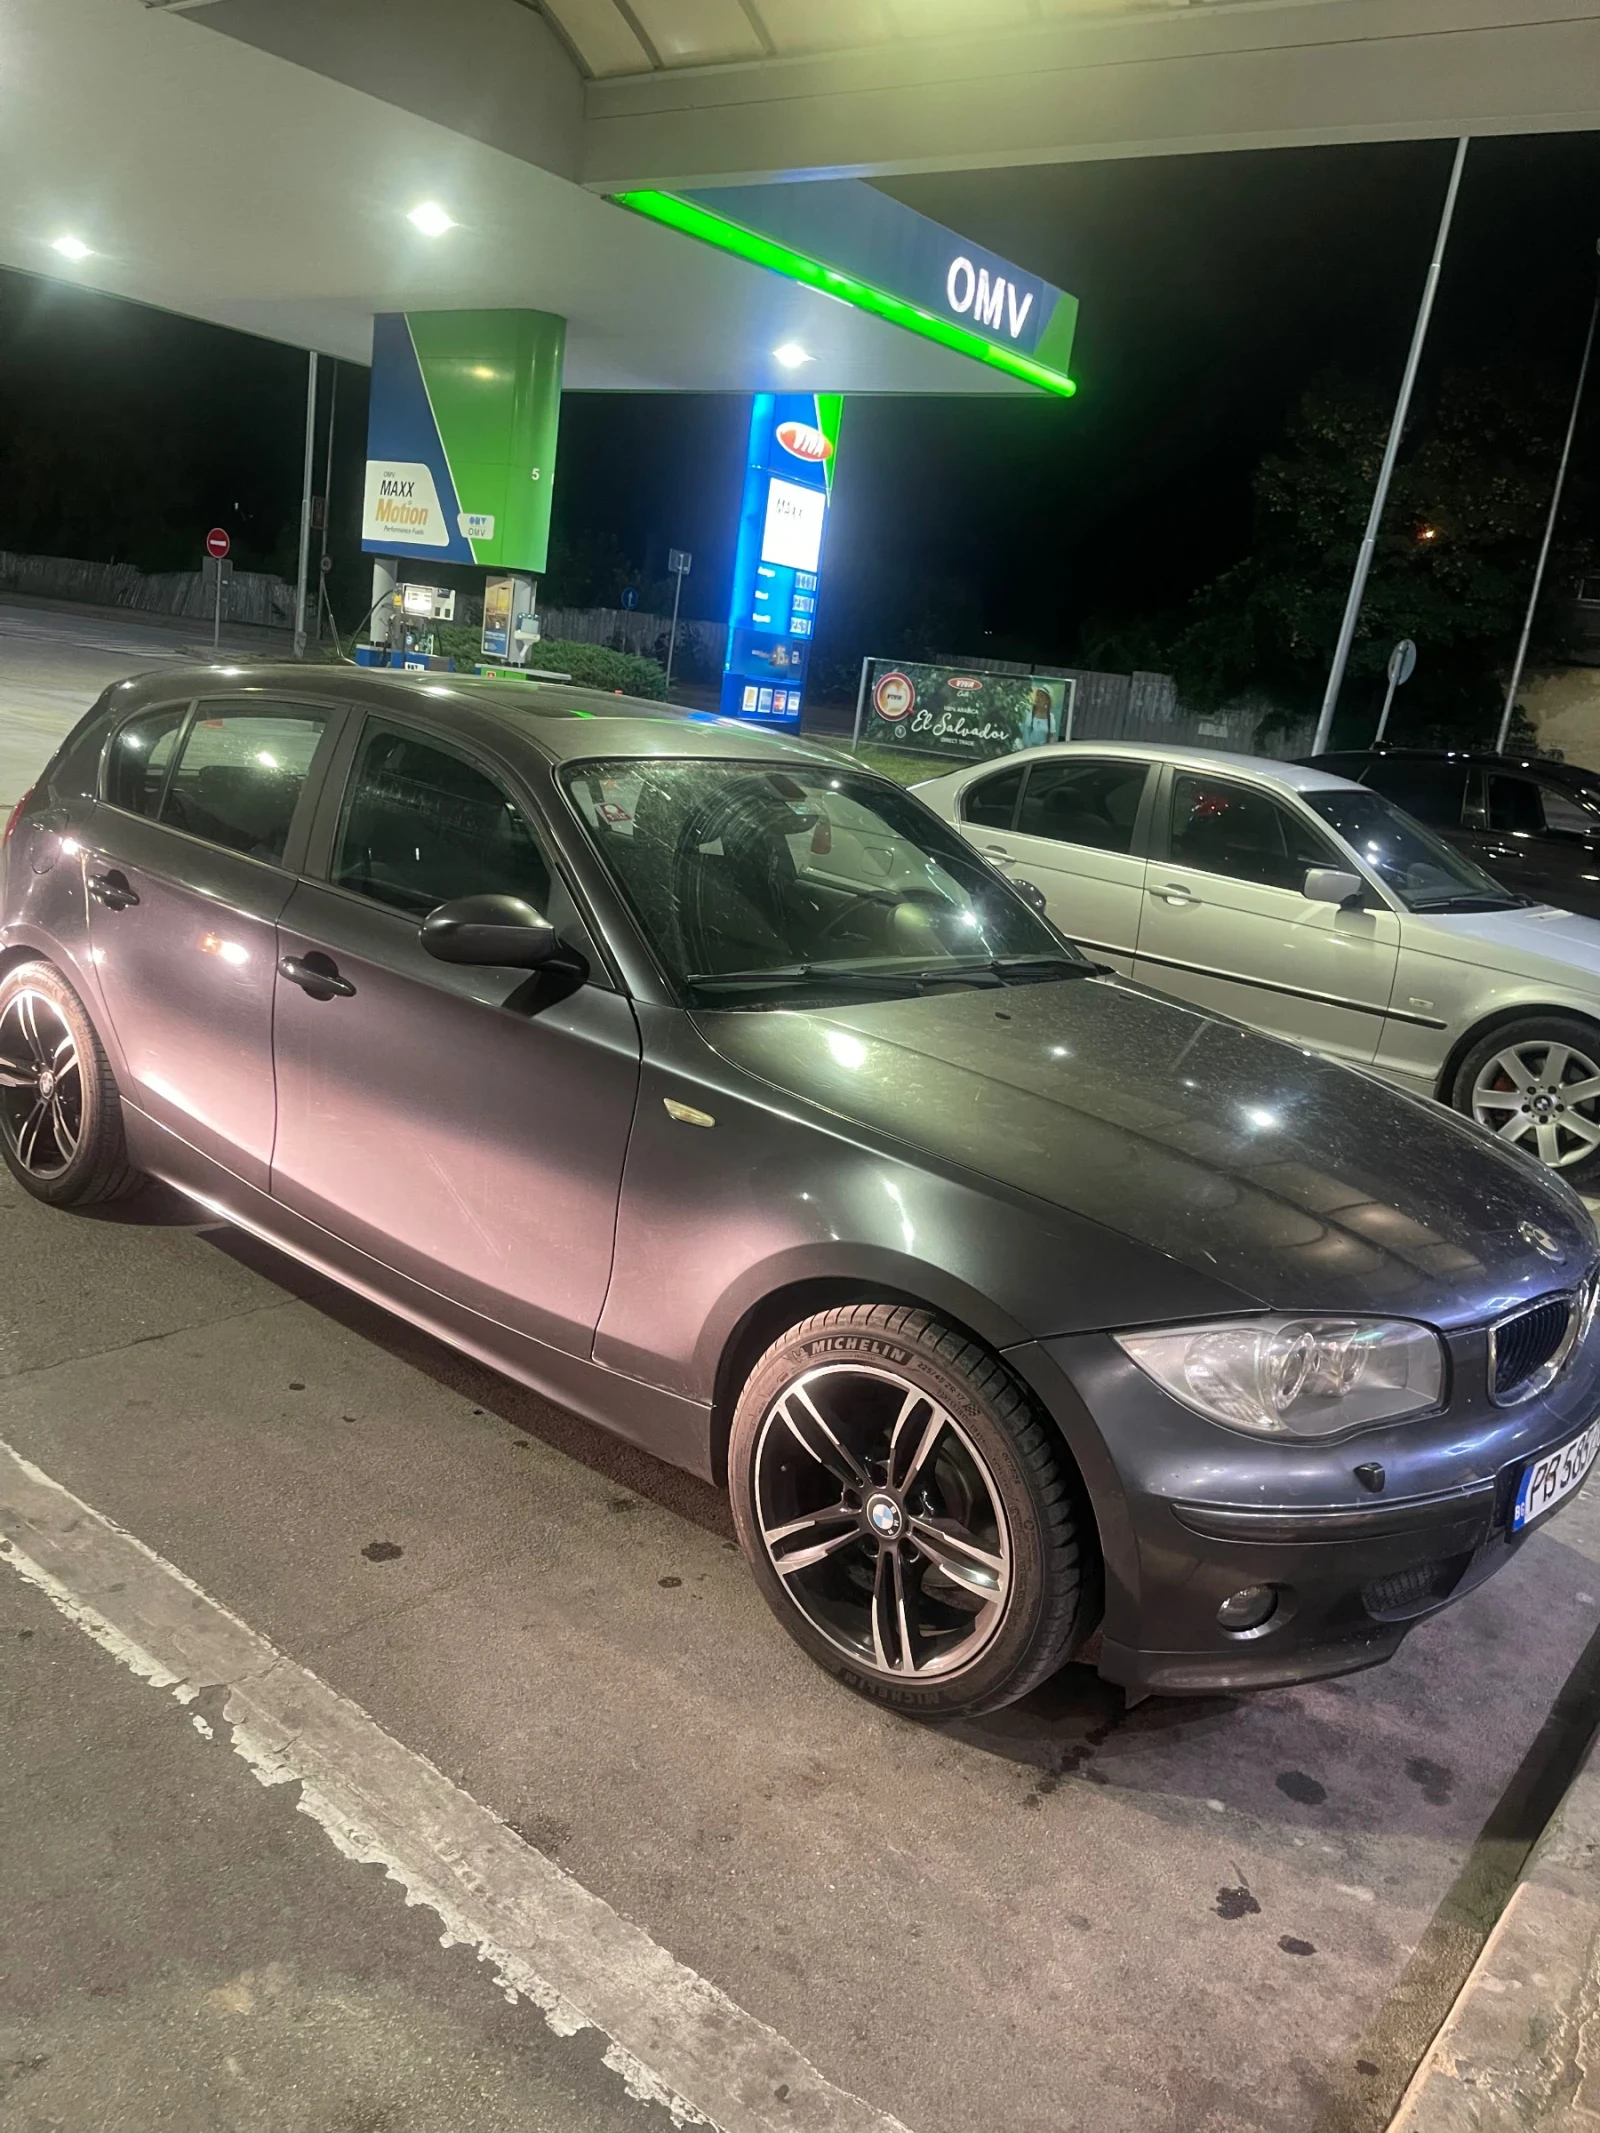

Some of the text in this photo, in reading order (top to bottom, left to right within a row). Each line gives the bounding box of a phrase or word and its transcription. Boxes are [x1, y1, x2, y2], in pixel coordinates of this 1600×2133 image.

[947, 256, 1034, 339] OMV
[531, 467, 540, 481] 5
[380, 480, 415, 497] MAXX
[375, 498, 429, 526] Motion
[468, 528, 486, 537] OMV
[911, 709, 1010, 740] El Salvador
[812, 1338, 906, 1361] MICHELIN
[917, 1361, 944, 1384] 225/45
[1529, 1453, 1562, 1513] PB
[1515, 1502, 1525, 1521] BG
